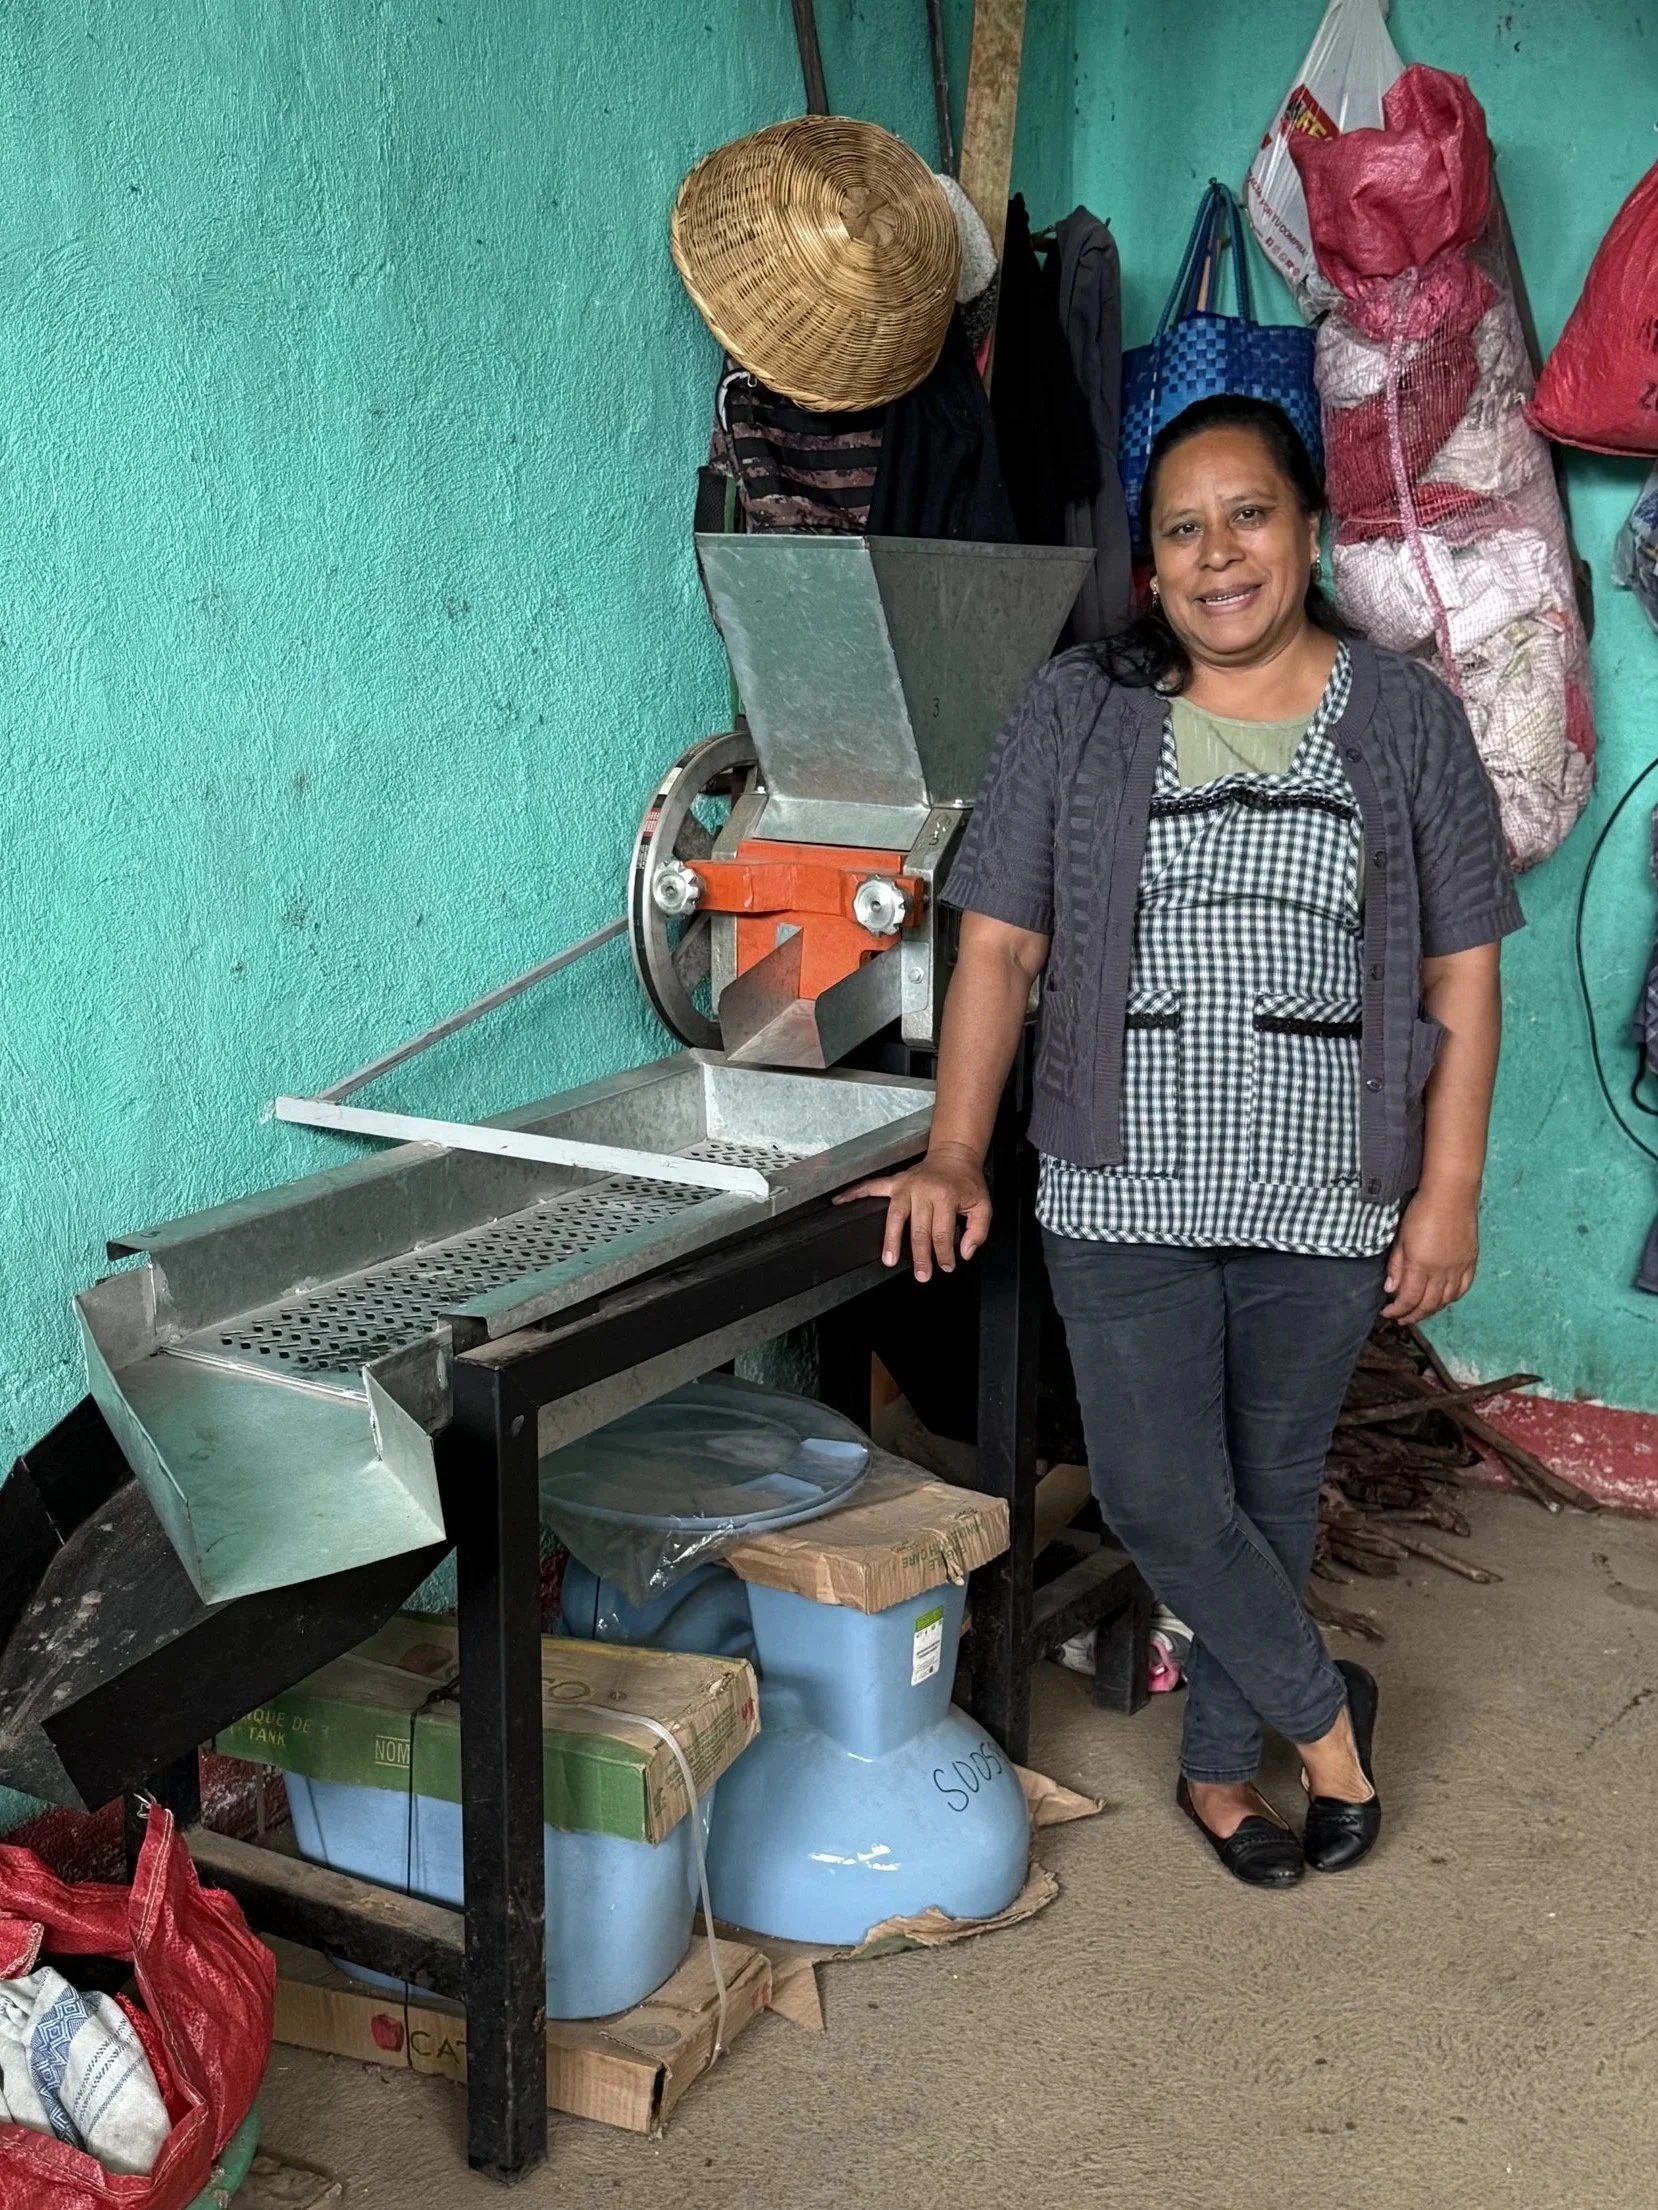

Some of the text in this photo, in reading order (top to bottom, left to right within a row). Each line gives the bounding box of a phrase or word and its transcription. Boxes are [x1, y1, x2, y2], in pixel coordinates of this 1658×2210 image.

[901, 1547, 929, 1570] CARE
[291, 1715, 312, 1734] DE
[248, 1726, 287, 1747] TANK
[374, 1739, 410, 1764] NOM
